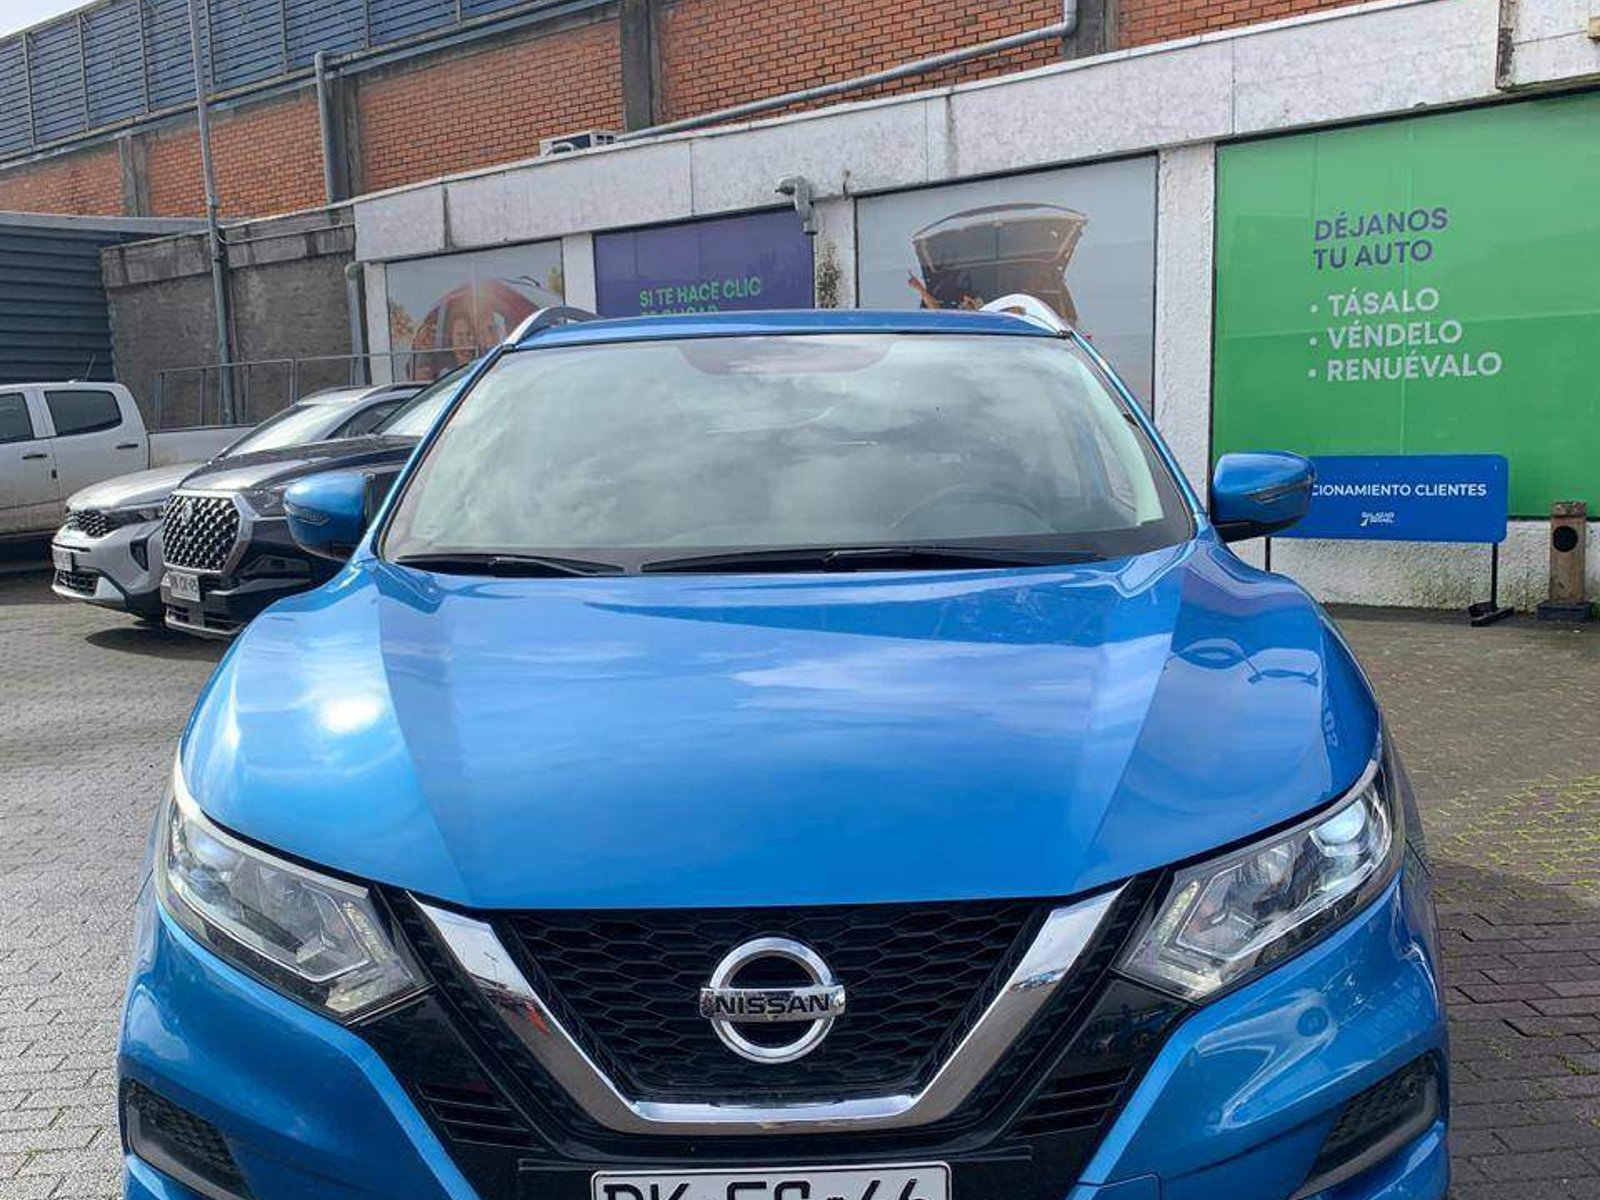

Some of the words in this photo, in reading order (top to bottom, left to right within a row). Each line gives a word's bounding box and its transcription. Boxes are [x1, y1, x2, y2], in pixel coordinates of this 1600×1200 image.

[1314, 207, 1449, 242] DÉJANOS
[1313, 246, 1347, 271] TU
[1354, 239, 1434, 268] AUTO
[639, 290, 653, 306] SI
[655, 287, 674, 305] TE
[676, 281, 720, 303] HACE
[722, 276, 762, 299] CLIC
[1328, 287, 1440, 317] TÁSALO
[1327, 319, 1463, 350] VÉNDELO
[1327, 350, 1503, 382] RENUÉVALO
[1414, 483, 1488, 497] CLIENTES
[715, 993, 830, 1015] NISSAN
